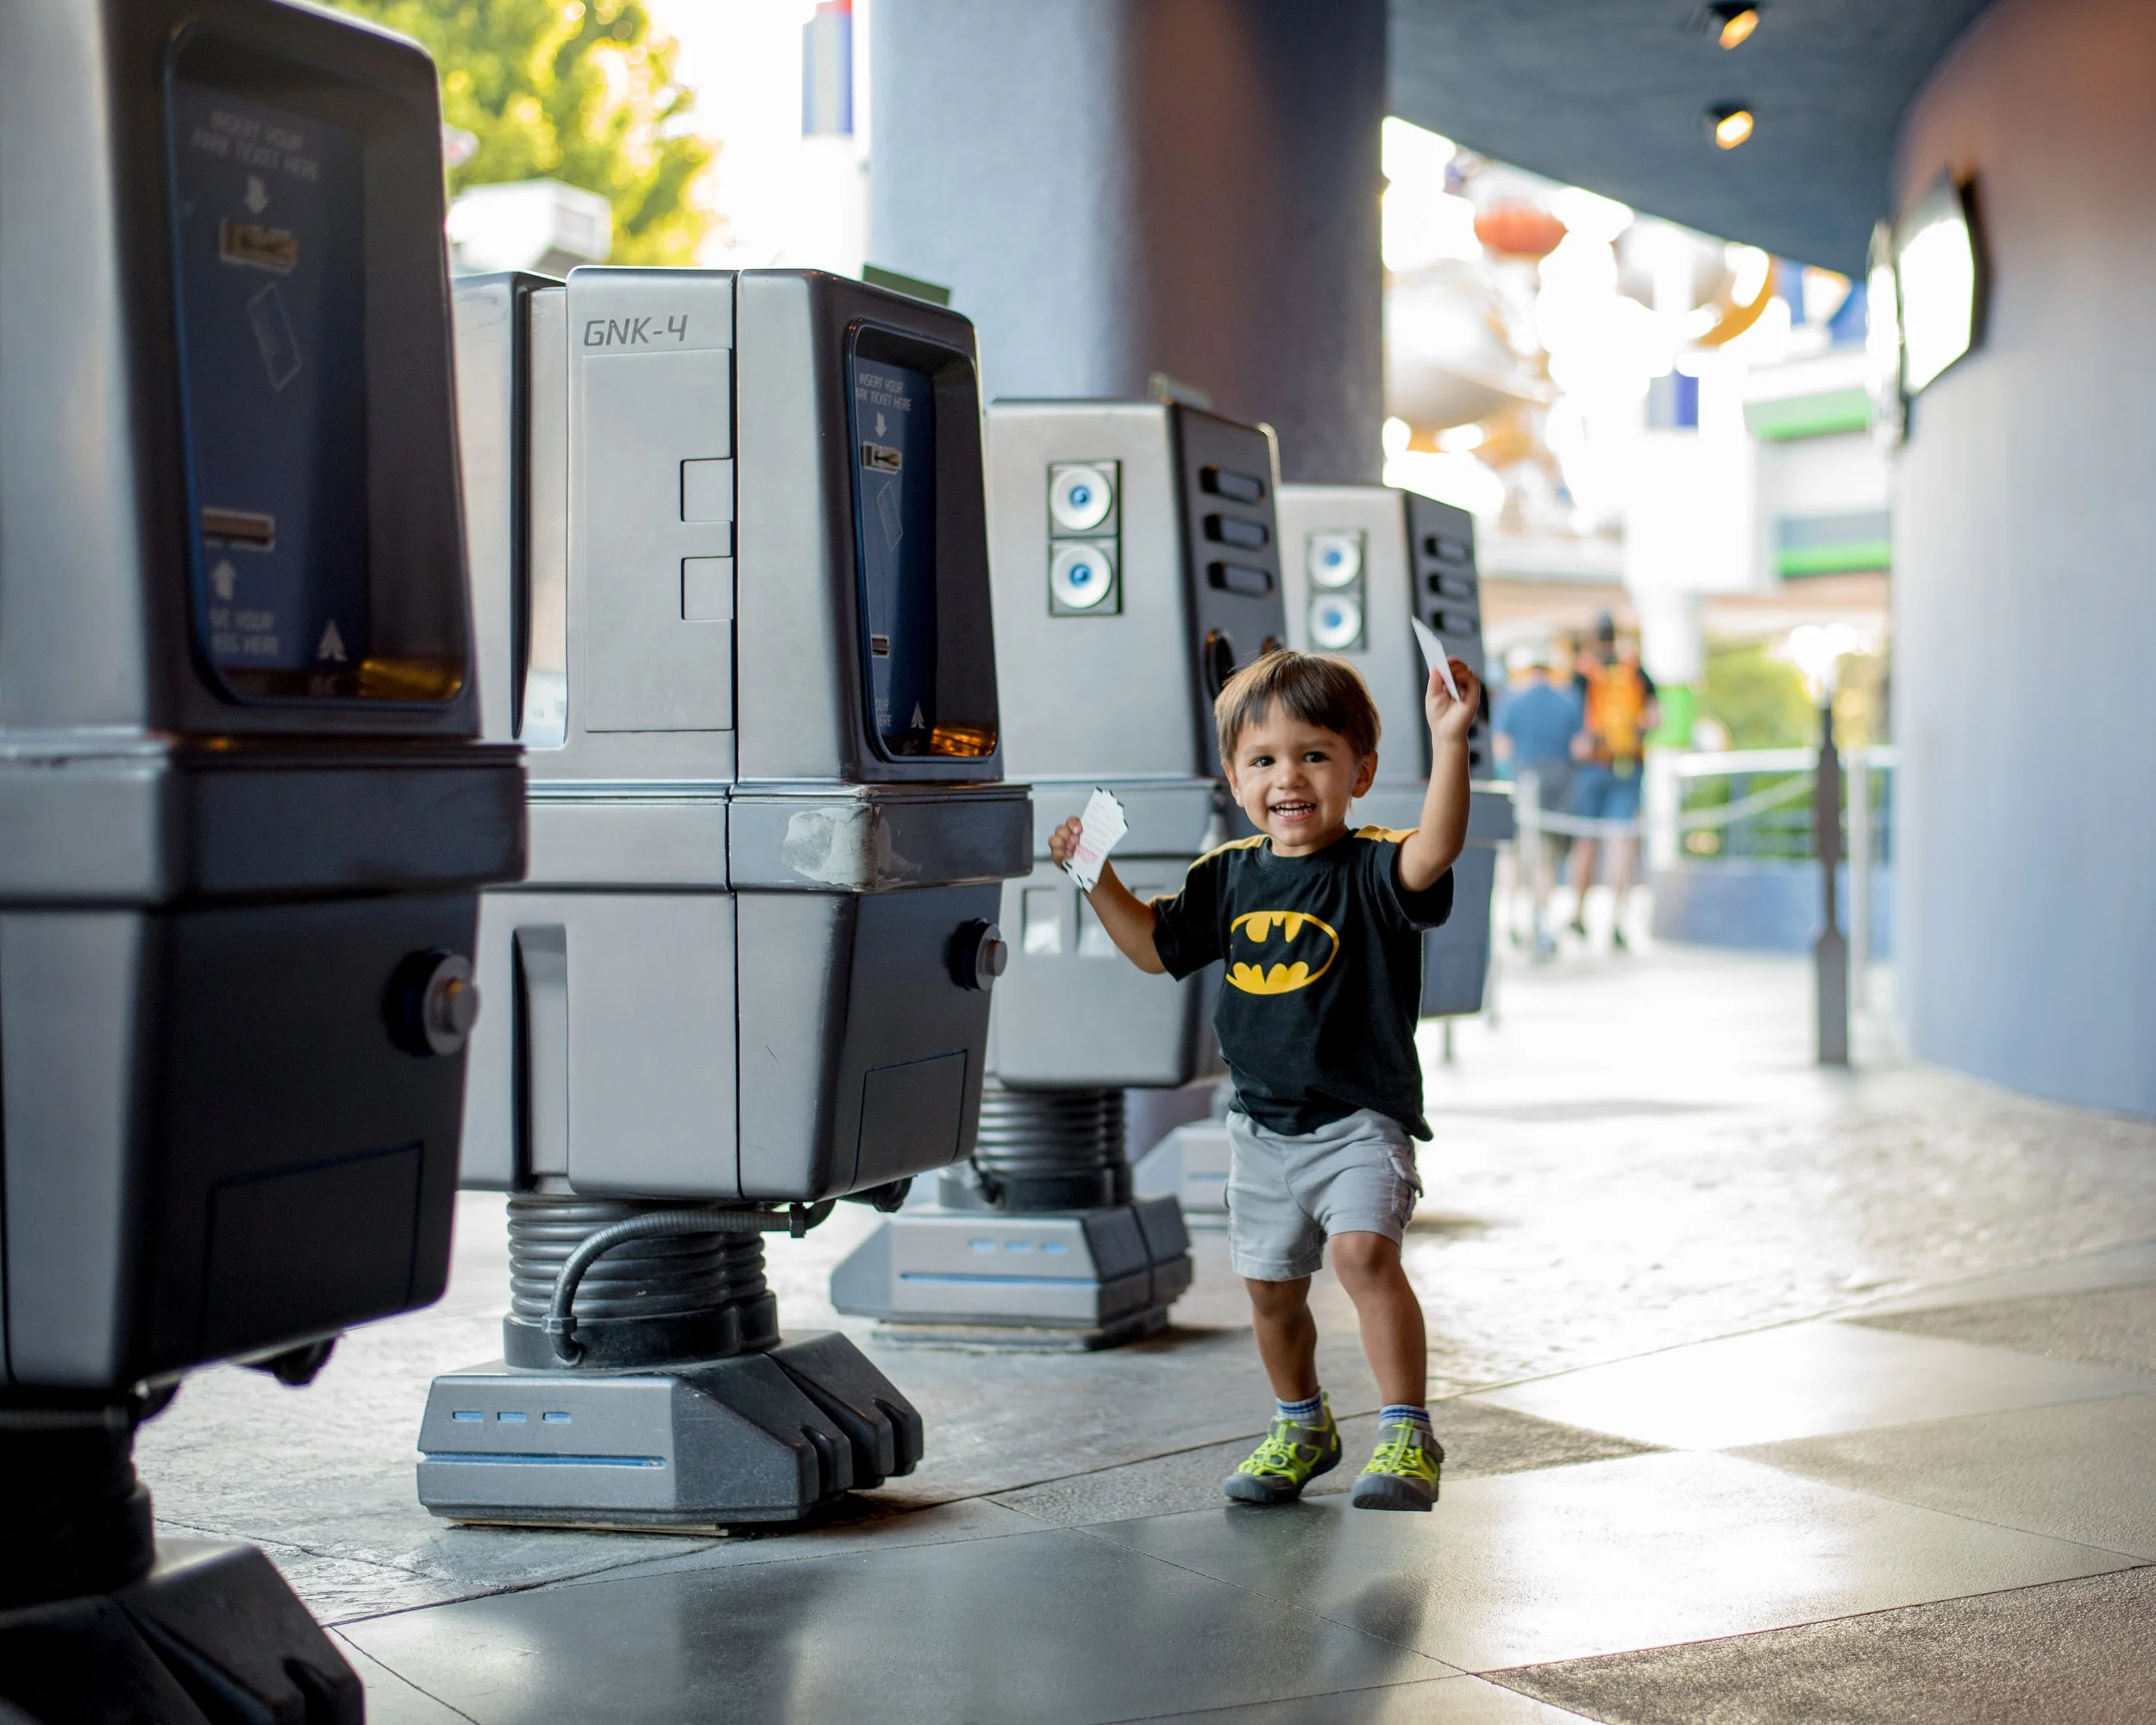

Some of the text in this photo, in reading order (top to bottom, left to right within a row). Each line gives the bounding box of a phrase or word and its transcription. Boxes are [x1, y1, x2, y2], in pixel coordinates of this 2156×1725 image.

[584, 315, 688, 346] GNK-4
[858, 372, 904, 394] INSERT YOUR
[869, 391, 892, 406] TICKET
[893, 396, 912, 411] HERE
